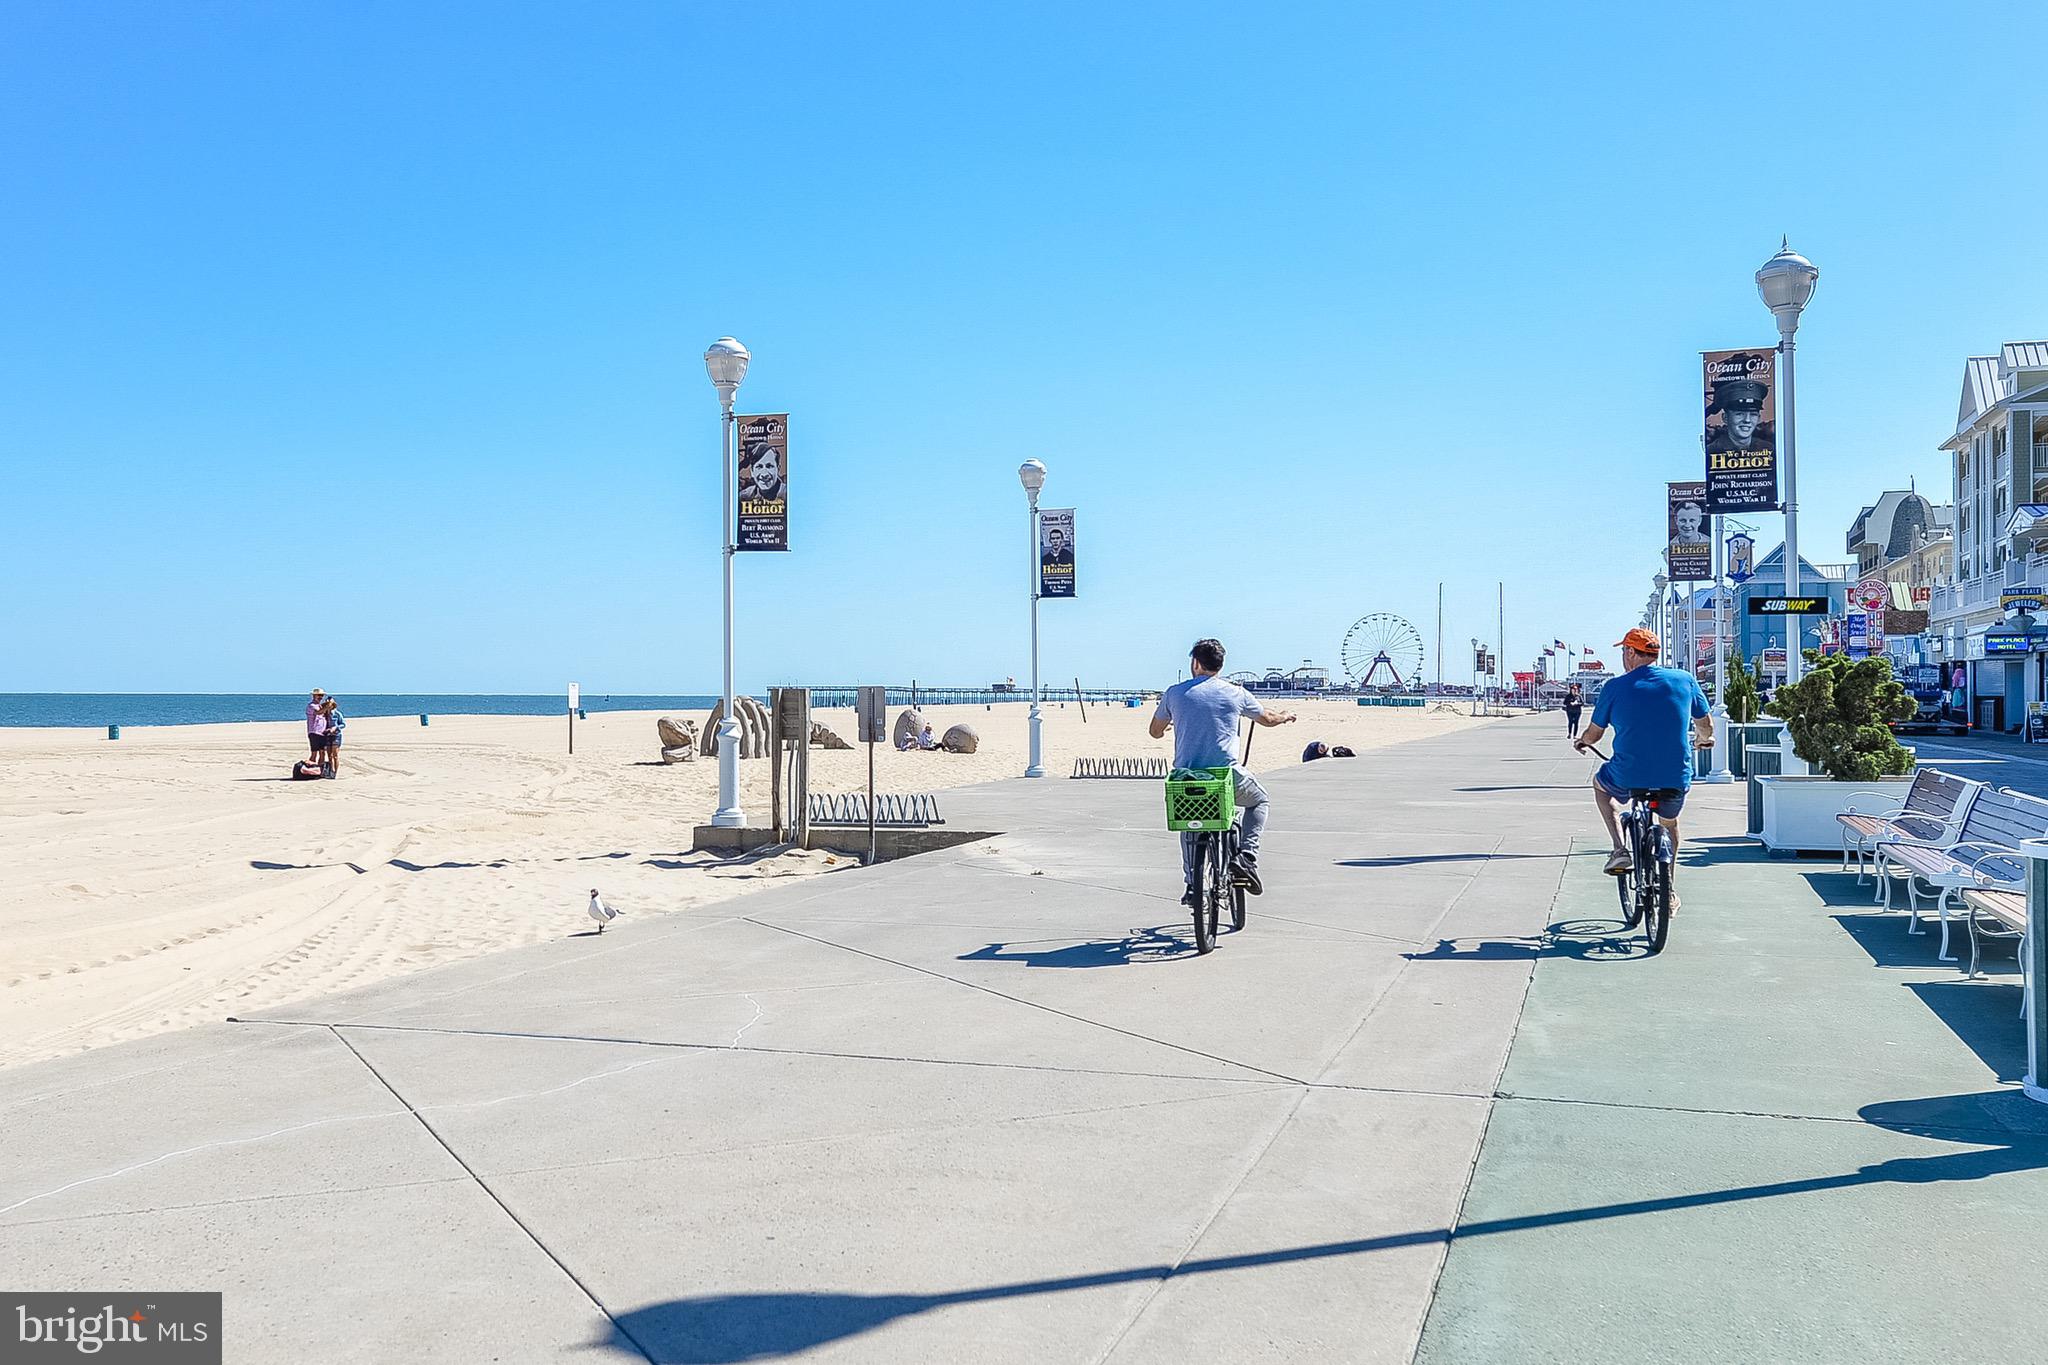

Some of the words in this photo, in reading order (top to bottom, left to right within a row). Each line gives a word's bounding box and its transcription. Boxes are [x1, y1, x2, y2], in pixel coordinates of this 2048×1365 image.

[1707, 362, 1742, 373] Ocean
[1746, 359, 1771, 374] City
[740, 424, 764, 434] Ocean
[767, 422, 784, 435] City
[1741, 449, 1773, 457] Proudly
[1710, 454, 1771, 469] Honor
[1693, 487, 1706, 497] Cit
[741, 501, 783, 514] Honor
[1043, 565, 1072, 574] Honor
[1762, 599, 1816, 611] SUBWAY
[2007, 599, 2040, 609] JEWELERS
